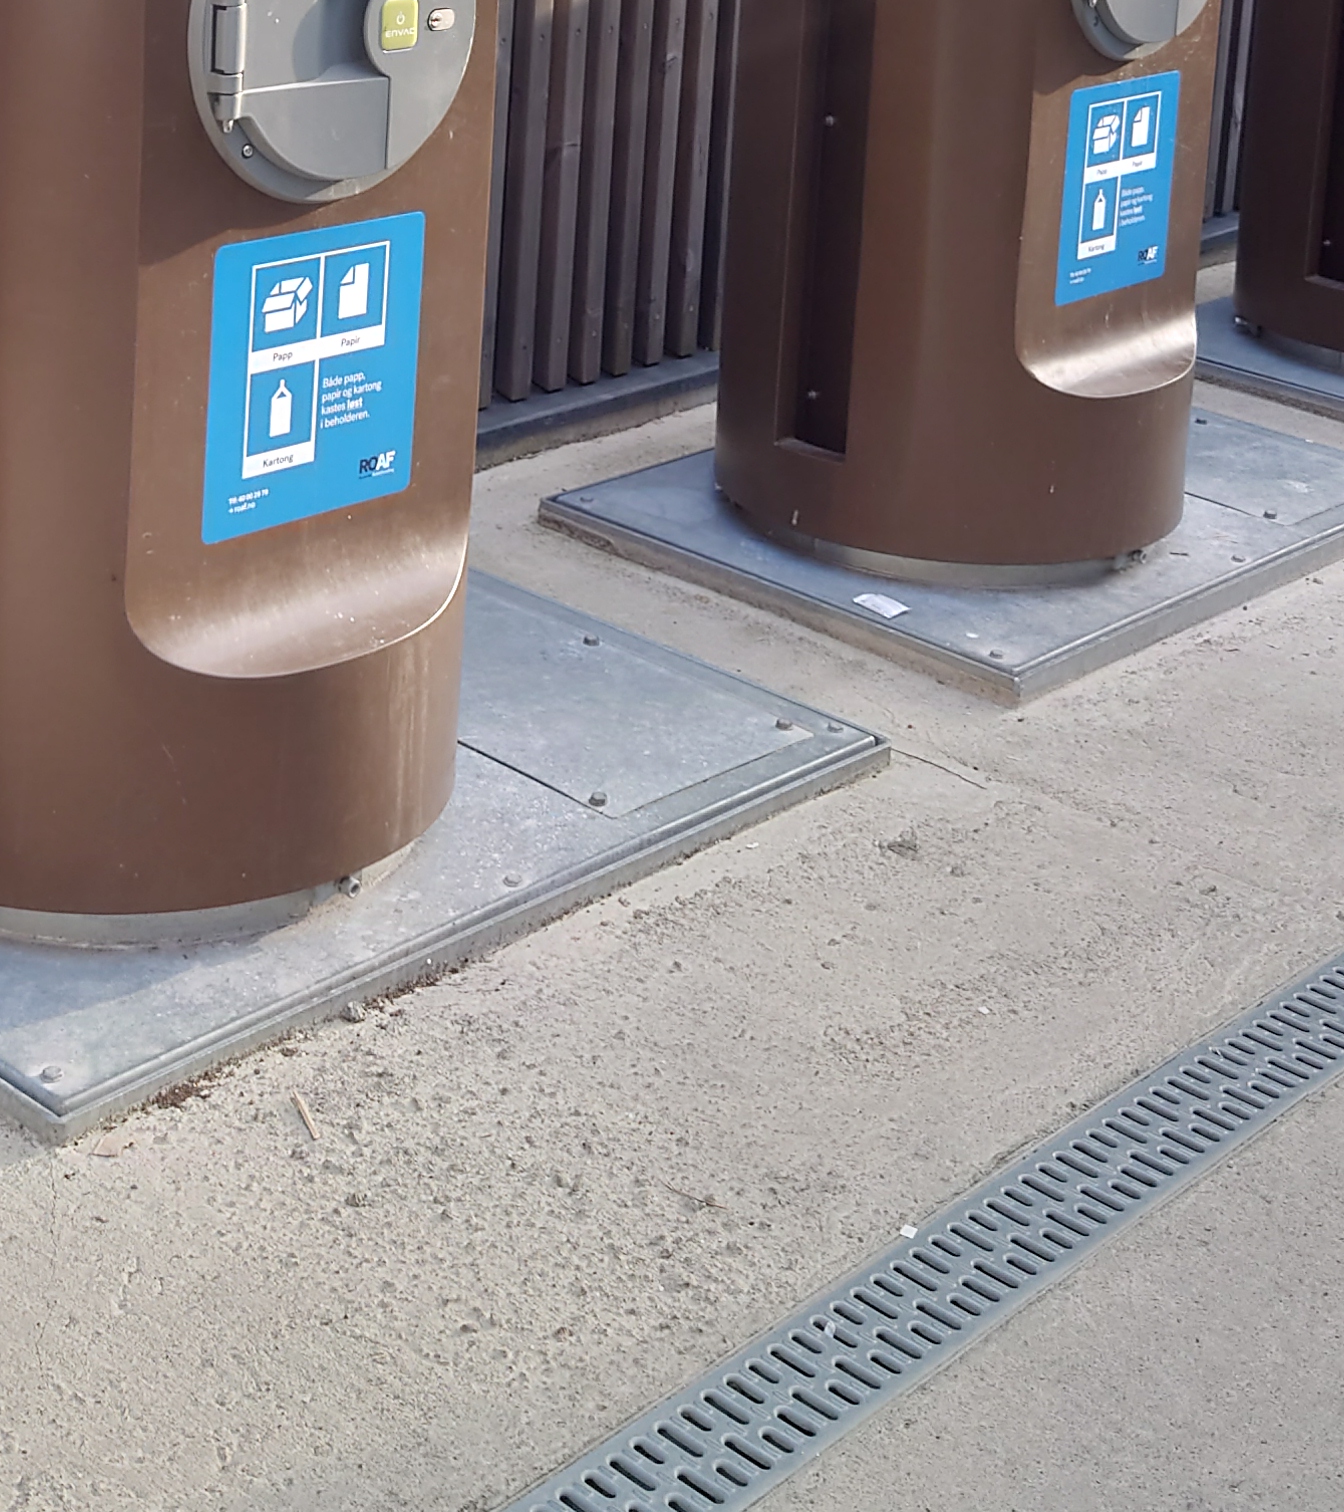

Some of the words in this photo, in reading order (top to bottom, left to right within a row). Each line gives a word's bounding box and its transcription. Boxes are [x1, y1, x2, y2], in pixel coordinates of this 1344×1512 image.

[340, 336, 361, 347] Papir
[272, 351, 294, 362] Papp
[322, 375, 343, 389] Både
[343, 371, 366, 386] papp,
[321, 388, 342, 404] papir
[342, 387, 353, 399] og
[353, 380, 382, 395] kartong
[321, 402, 346, 416] kastes
[324, 410, 370, 428] beholderen.
[262, 454, 294, 468] Kartong
[359, 450, 396, 474] ROAF
